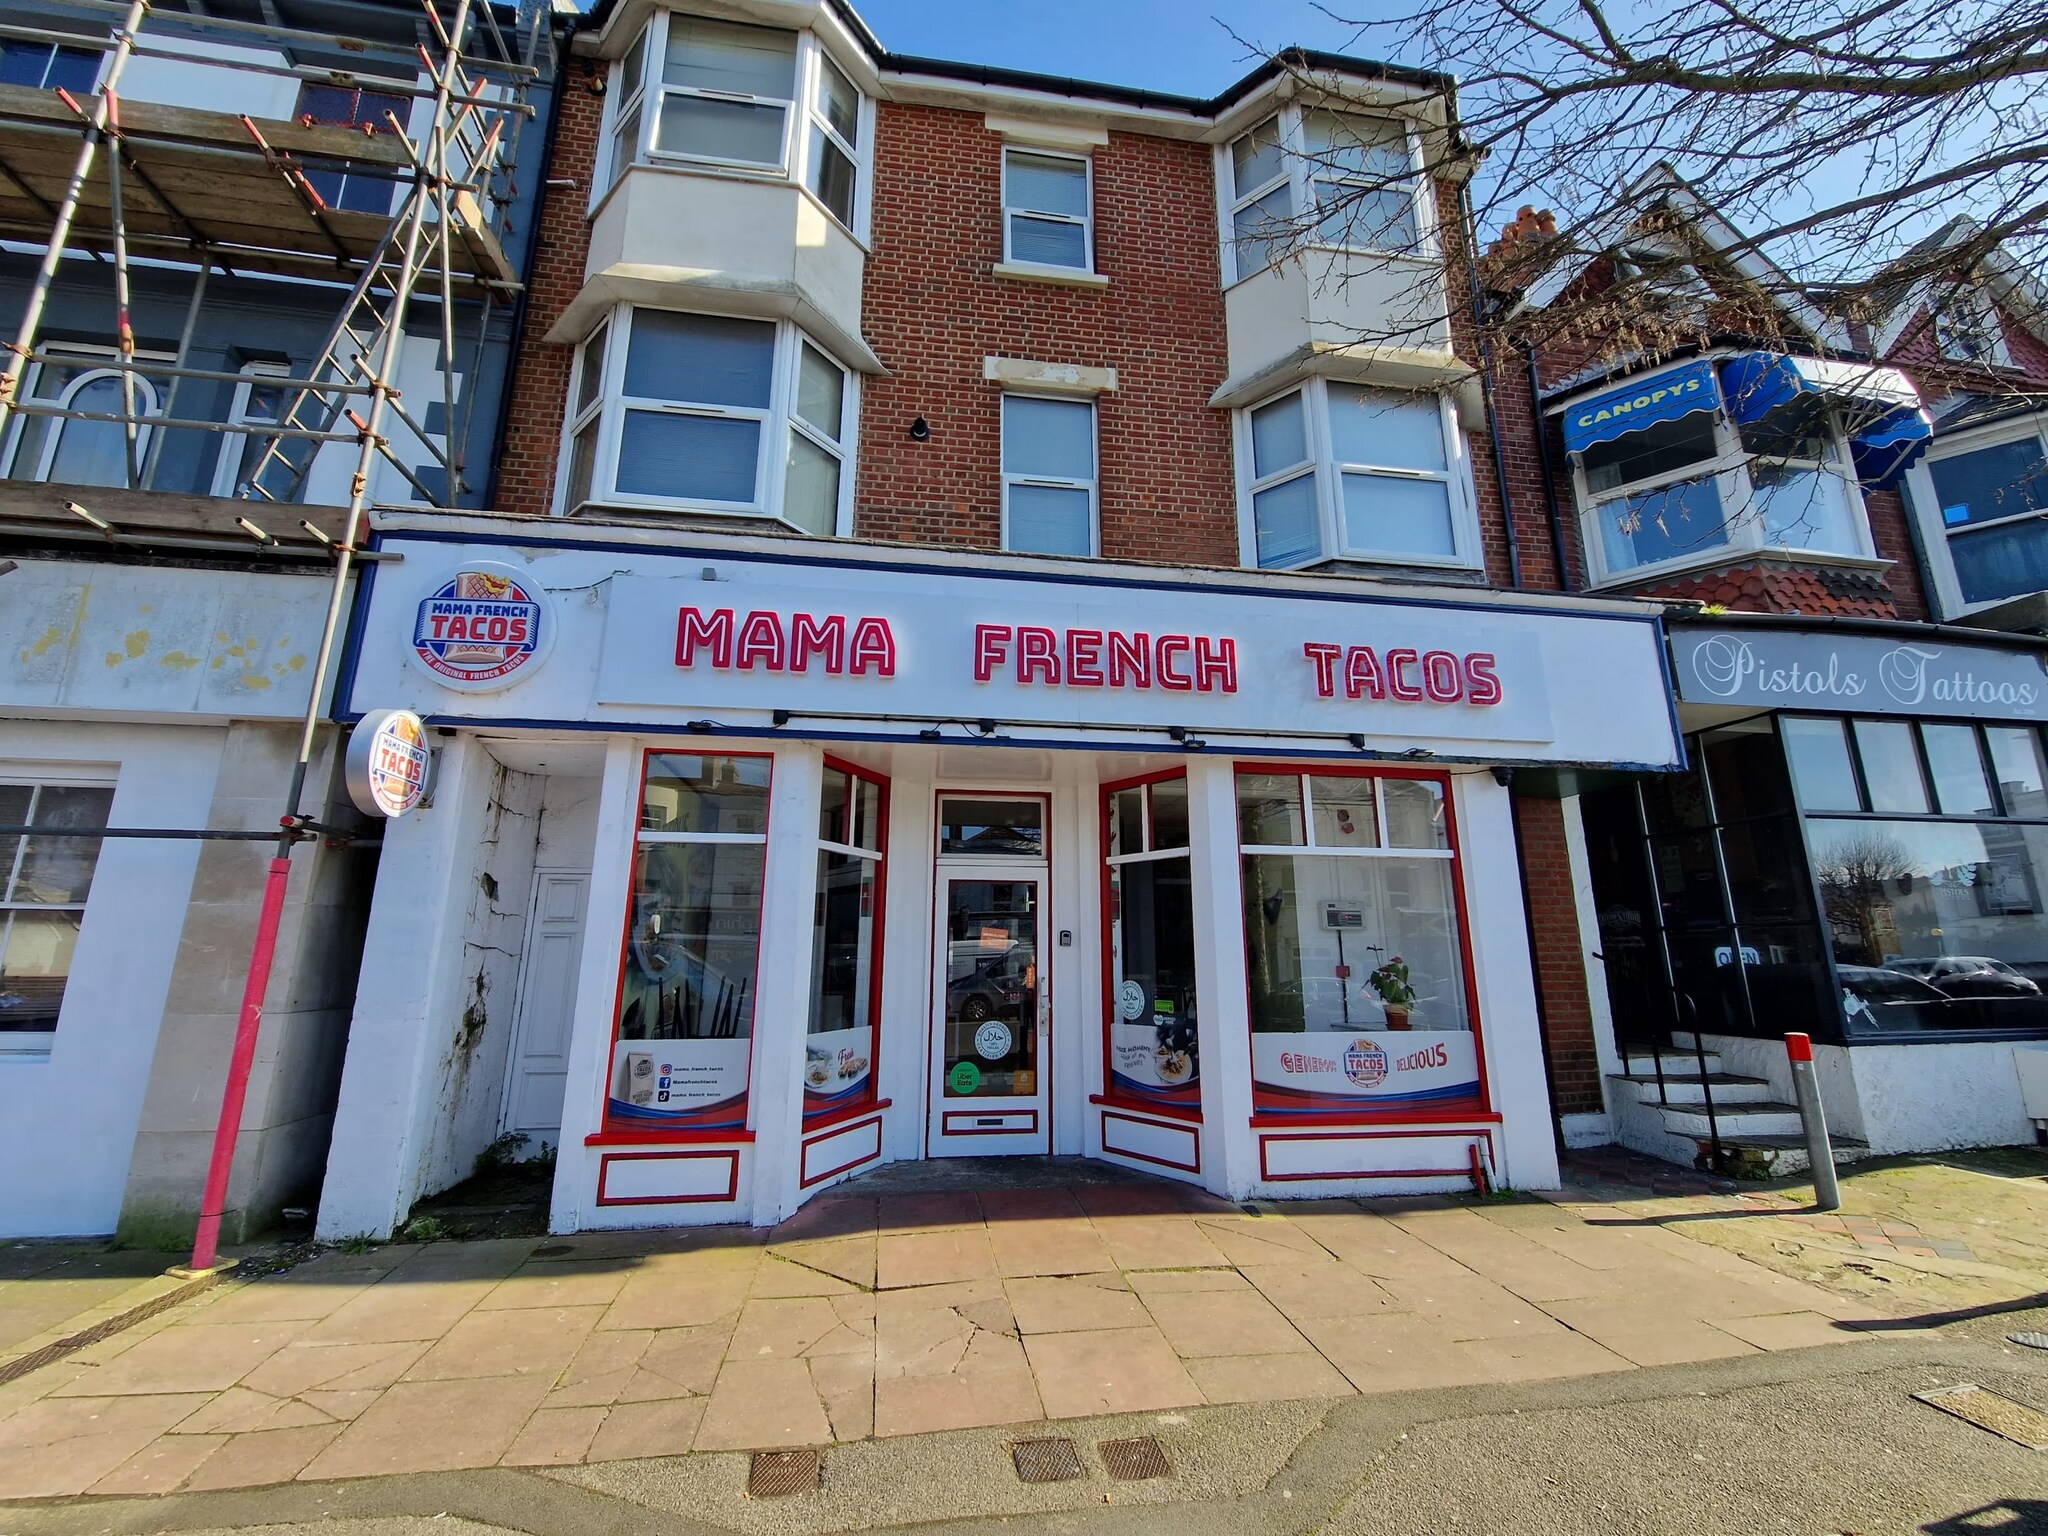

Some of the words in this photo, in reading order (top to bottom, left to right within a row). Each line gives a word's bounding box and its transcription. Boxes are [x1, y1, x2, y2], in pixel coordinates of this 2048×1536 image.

[1578, 378, 1700, 428] CANOPYS
[432, 602, 473, 616] MAMA
[475, 604, 529, 617] FRENCH
[431, 616, 527, 642] TACOS
[422, 651, 434, 665] THE
[433, 660, 468, 680] ORIGINAL
[470, 668, 500, 681] FRENCH
[501, 654, 525, 674] TACOS
[675, 606, 896, 679] MAMA
[973, 623, 1238, 695] FRENCH
[1303, 641, 1502, 708] TACOS
[1692, 634, 1867, 697] Pistols
[1878, 646, 2040, 705] Tattoos
[383, 737, 400, 753] MAMA
[401, 745, 424, 762] FRENCH
[381, 749, 421, 782] TACOS
[1348, 1059, 1384, 1070] TACOS
[1396, 1042, 1448, 1072] DELICIOUS
